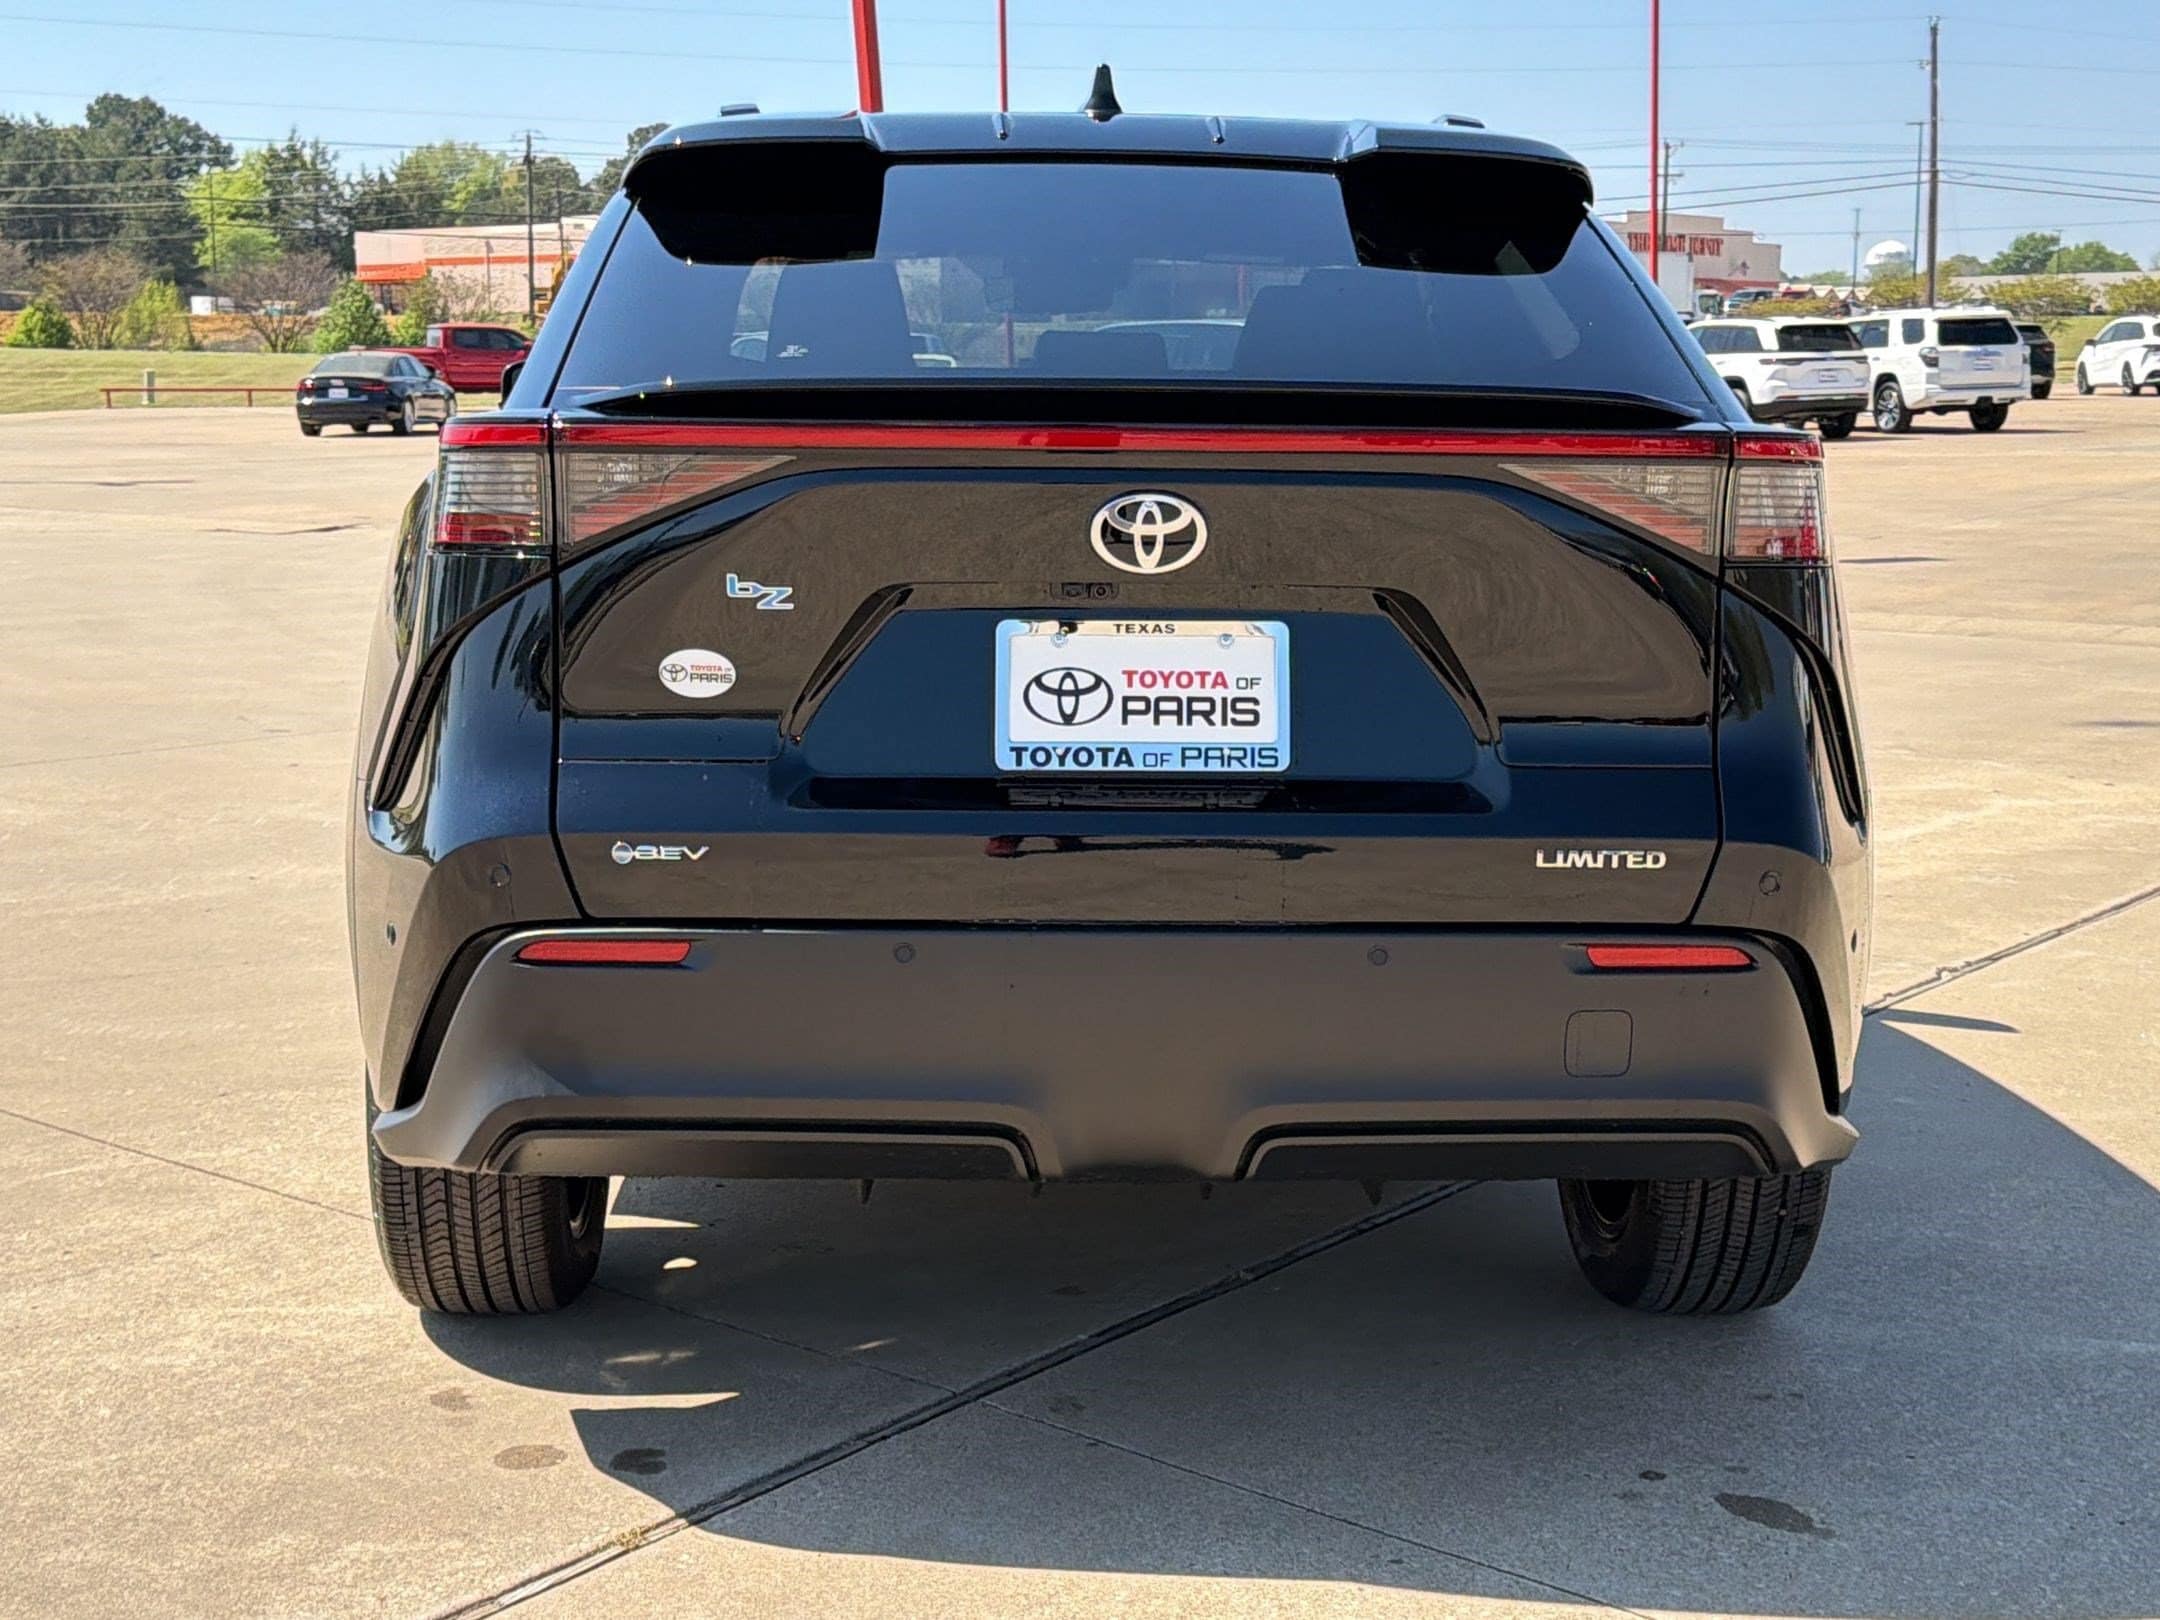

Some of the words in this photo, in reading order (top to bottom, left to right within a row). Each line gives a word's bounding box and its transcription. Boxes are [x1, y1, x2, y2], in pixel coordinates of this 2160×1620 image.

[1113, 623, 1176, 634] TEXAS
[690, 664, 723, 672] TOYOTA
[690, 672, 733, 684] PARIS
[1121, 669, 1229, 689] TOYOTA
[1236, 677, 1262, 690] OF
[1121, 696, 1260, 726] PARIS
[1009, 746, 1134, 768] TOYOTA
[1143, 753, 1173, 768] OF
[1180, 747, 1279, 768] PARIS
[1536, 849, 1667, 868] LIMITED
